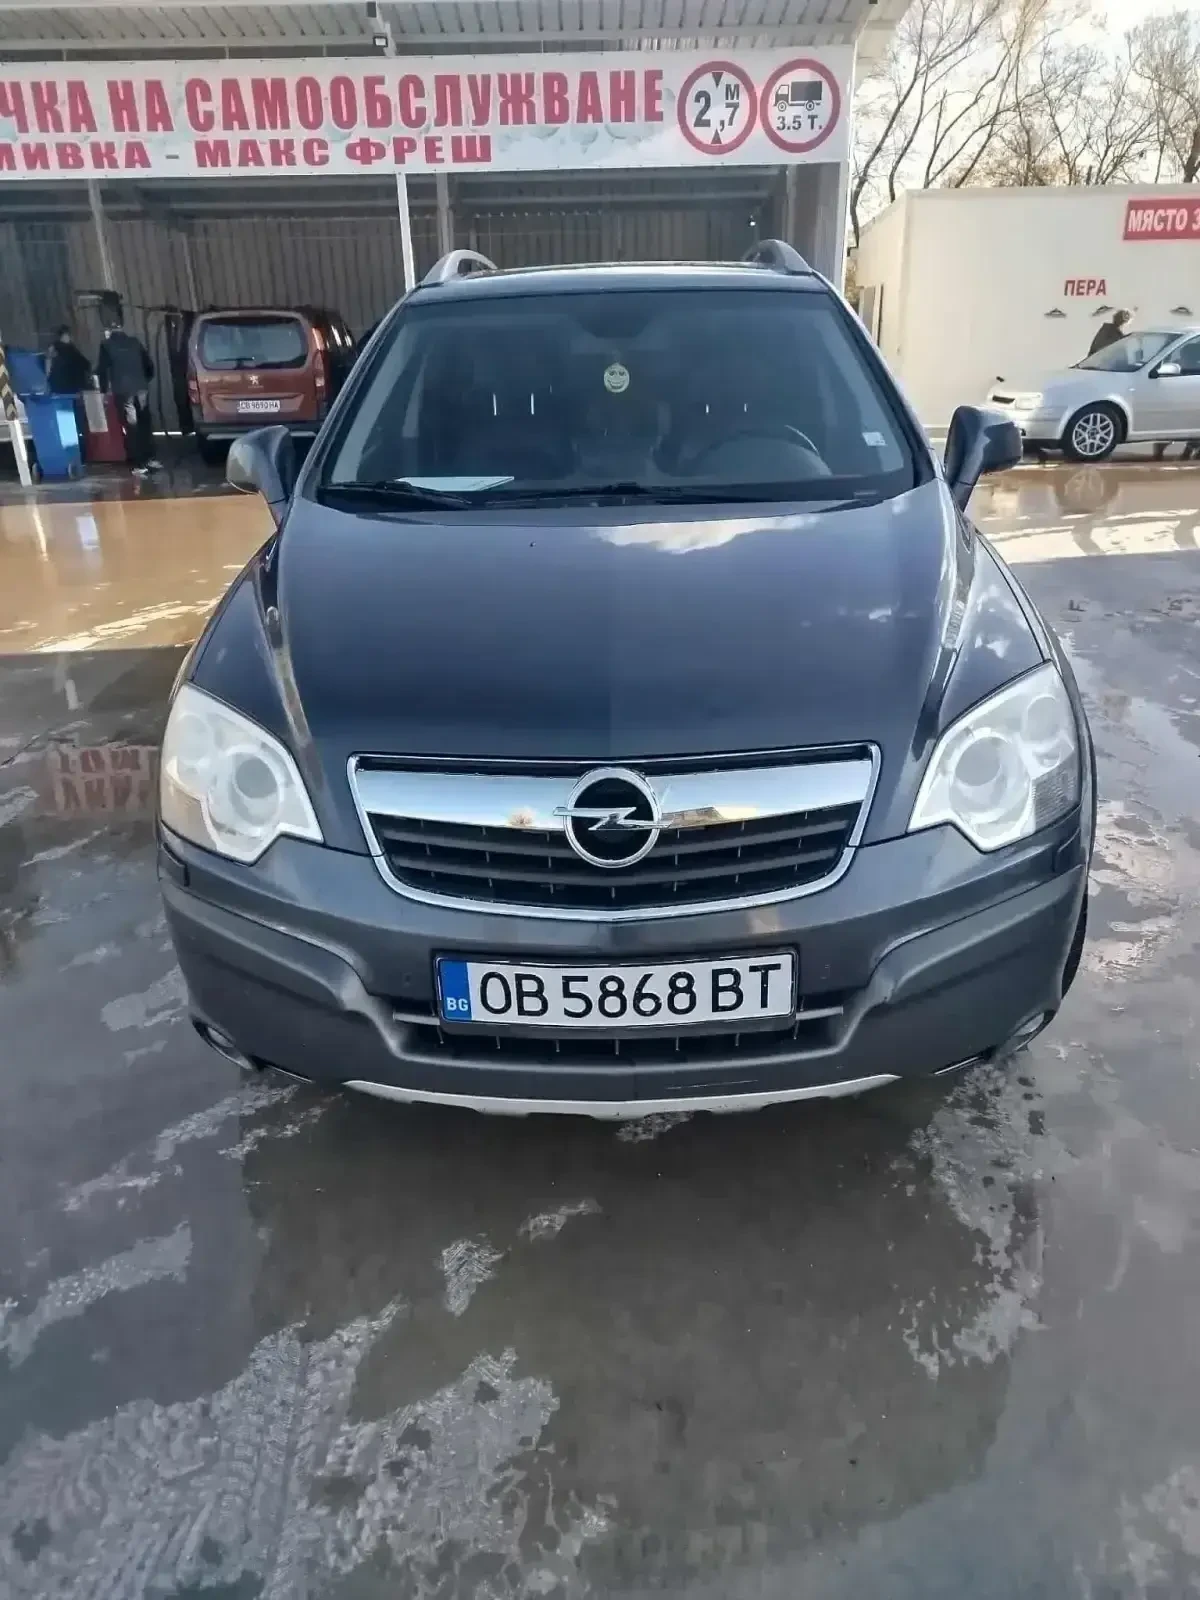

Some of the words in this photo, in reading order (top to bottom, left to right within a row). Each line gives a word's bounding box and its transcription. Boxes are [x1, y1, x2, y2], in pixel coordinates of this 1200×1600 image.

[0, 80, 98, 134] ЧКА
[106, 79, 175, 133] НА
[184, 69, 664, 133] САМООБСЛУЖВАНЕ
[776, 115, 802, 131] 3.5
[195, 137, 330, 168] МАКС
[345, 134, 492, 166] ФРЕШ
[1127, 208, 1188, 232] МЯСТО
[1064, 279, 1107, 296] ПЕРА
[561, 971, 697, 1019] 5868
[710, 963, 782, 1014] BT
[446, 997, 469, 1012] BG
